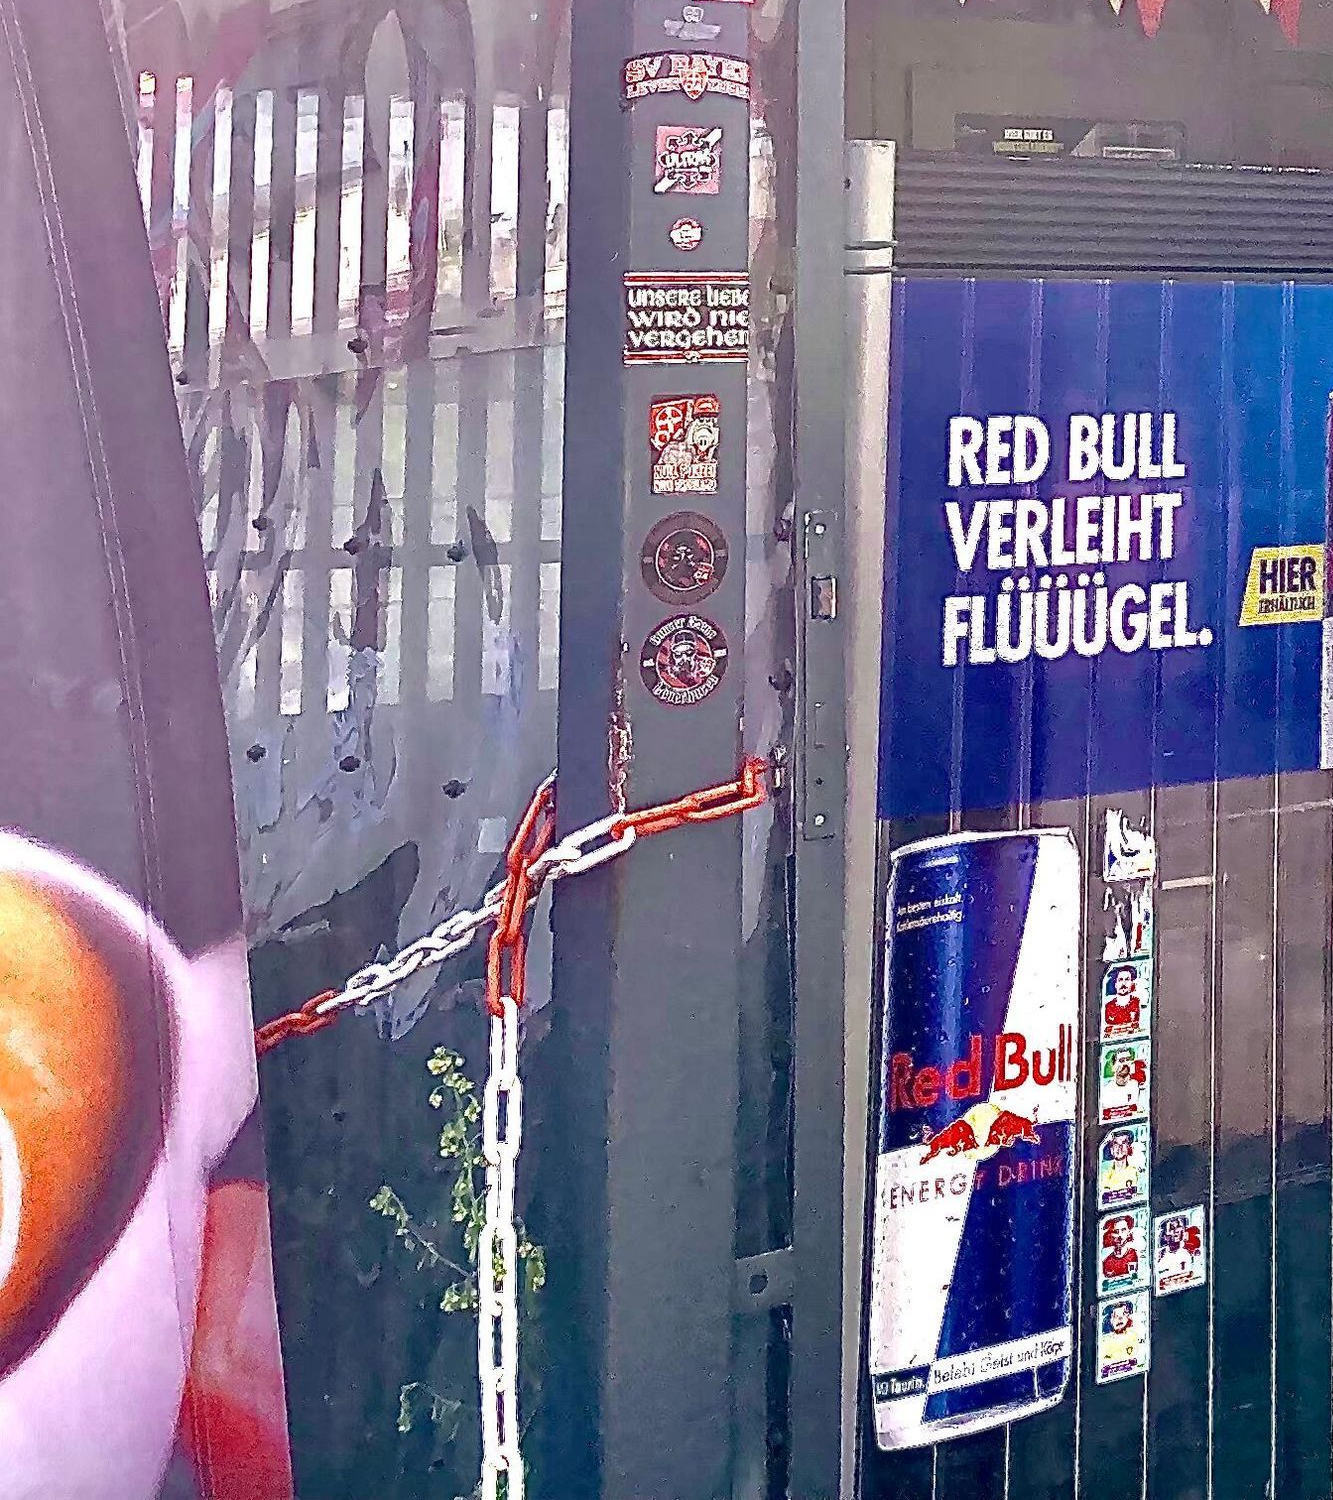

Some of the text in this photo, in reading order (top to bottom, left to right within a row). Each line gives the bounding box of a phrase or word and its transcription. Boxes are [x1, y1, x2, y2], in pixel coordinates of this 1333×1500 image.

[948, 413, 1185, 487] RED BULL
[945, 493, 1184, 571] VERLEIHT
[1258, 595, 1315, 614] ERHÄLTLICH
[1260, 556, 1317, 594] HIER
[942, 572, 1213, 668] FLÜÜÜGEL.
[890, 1023, 1073, 1113] Red Bull
[890, 1154, 1064, 1210] ENERGY DRINK
